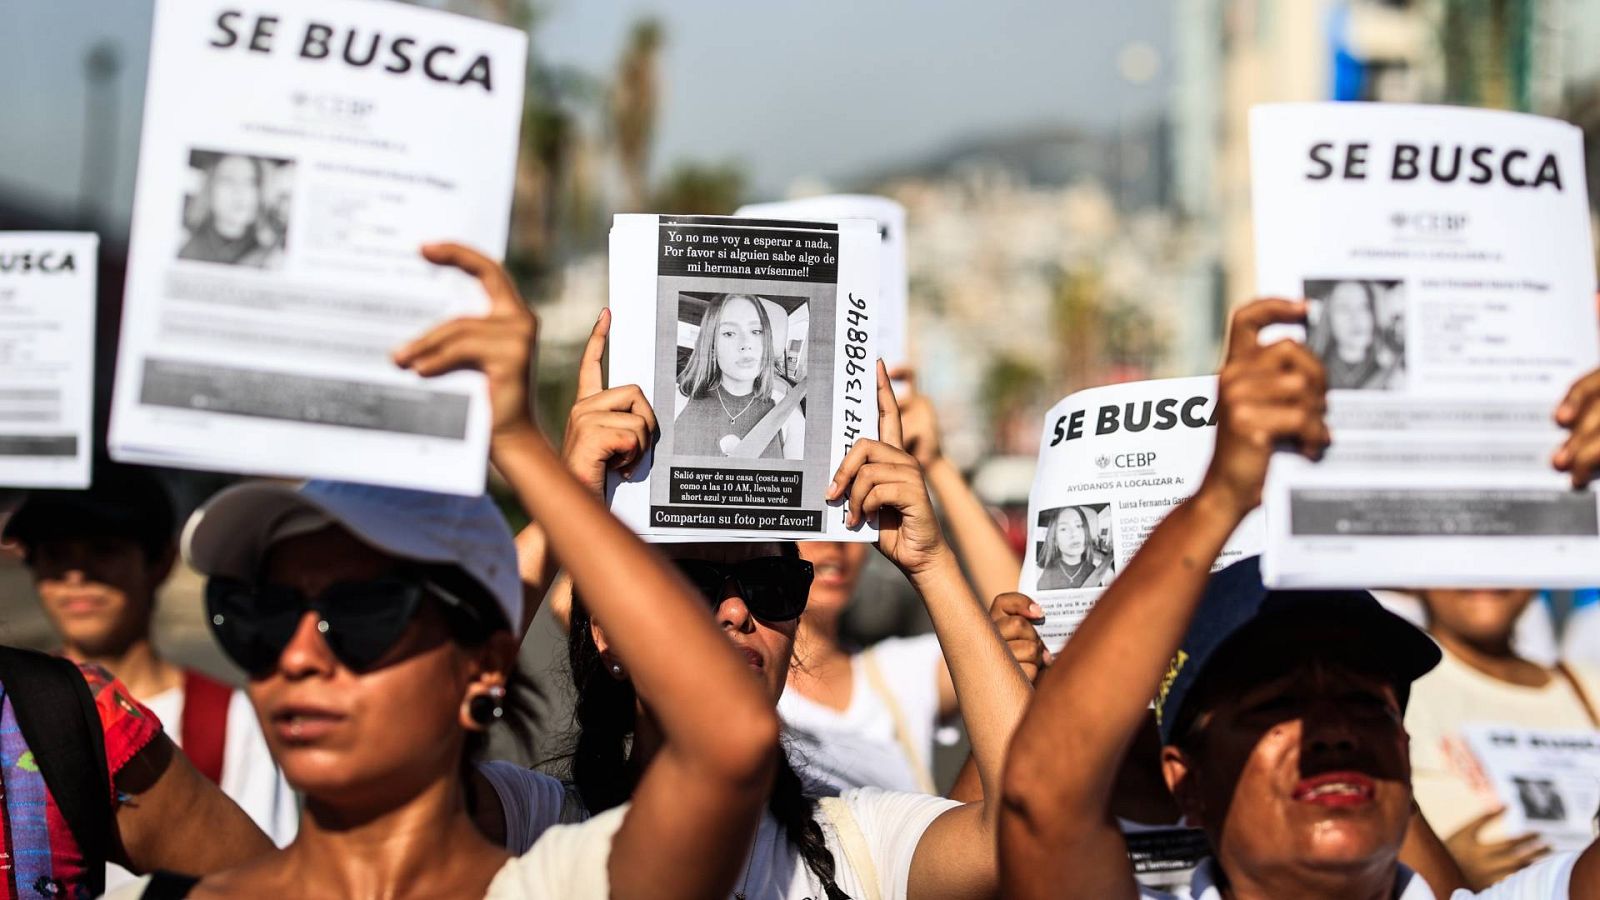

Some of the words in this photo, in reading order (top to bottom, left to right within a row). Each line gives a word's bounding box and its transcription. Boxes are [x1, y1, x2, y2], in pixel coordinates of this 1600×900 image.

[210, 10, 279, 53] SE
[300, 22, 493, 92] BUSCA
[1306, 142, 1370, 181] SE
[1391, 145, 1564, 191] BUSCA
[667, 231, 682, 243] Yo
[685, 235, 699, 244] no
[702, 235, 718, 244] me
[721, 236, 741, 247] voy
[743, 237, 751, 245] a
[753, 237, 793, 248] esperar
[795, 239, 802, 248] a
[804, 239, 832, 250] nada.
[664, 245, 684, 257] Por
[686, 247, 715, 258] favor
[717, 248, 727, 259] si
[730, 248, 770, 262] alguien
[772, 251, 796, 262] sabe
[798, 252, 821, 265] algo
[823, 253, 835, 264] de
[687, 261, 701, 272] mi
[704, 262, 751, 275] hermana
[754, 265, 810, 278] avísenme!!
[1050, 409, 1085, 447] SE
[1114, 451, 1157, 468] CEBP
[673, 471, 694, 481] Salió
[696, 473, 713, 482] ayer
[714, 472, 724, 481] de
[725, 474, 735, 482] su
[755, 473, 779, 483] (costa
[780, 474, 800, 484] azul)
[1124, 478, 1173, 489] LOCALIZAR
[1175, 476, 1184, 484] A:
[679, 483, 700, 491] como
[709, 482, 721, 491] las
[723, 483, 733, 492] 10
[735, 483, 752, 493] AM,
[753, 484, 781, 494] llevaba
[681, 493, 701, 502] short
[703, 494, 720, 502] azul
[721, 496, 727, 504] y
[745, 494, 766, 503] blusa
[767, 496, 789, 504] verde
[1119, 500, 1138, 509] Luisa
[1139, 498, 1171, 508] Fernanda
[655, 511, 715, 526] Compartan
[718, 516, 731, 525] su
[733, 513, 756, 525] foto
[758, 516, 777, 528] por
[779, 514, 814, 527] favor!!
